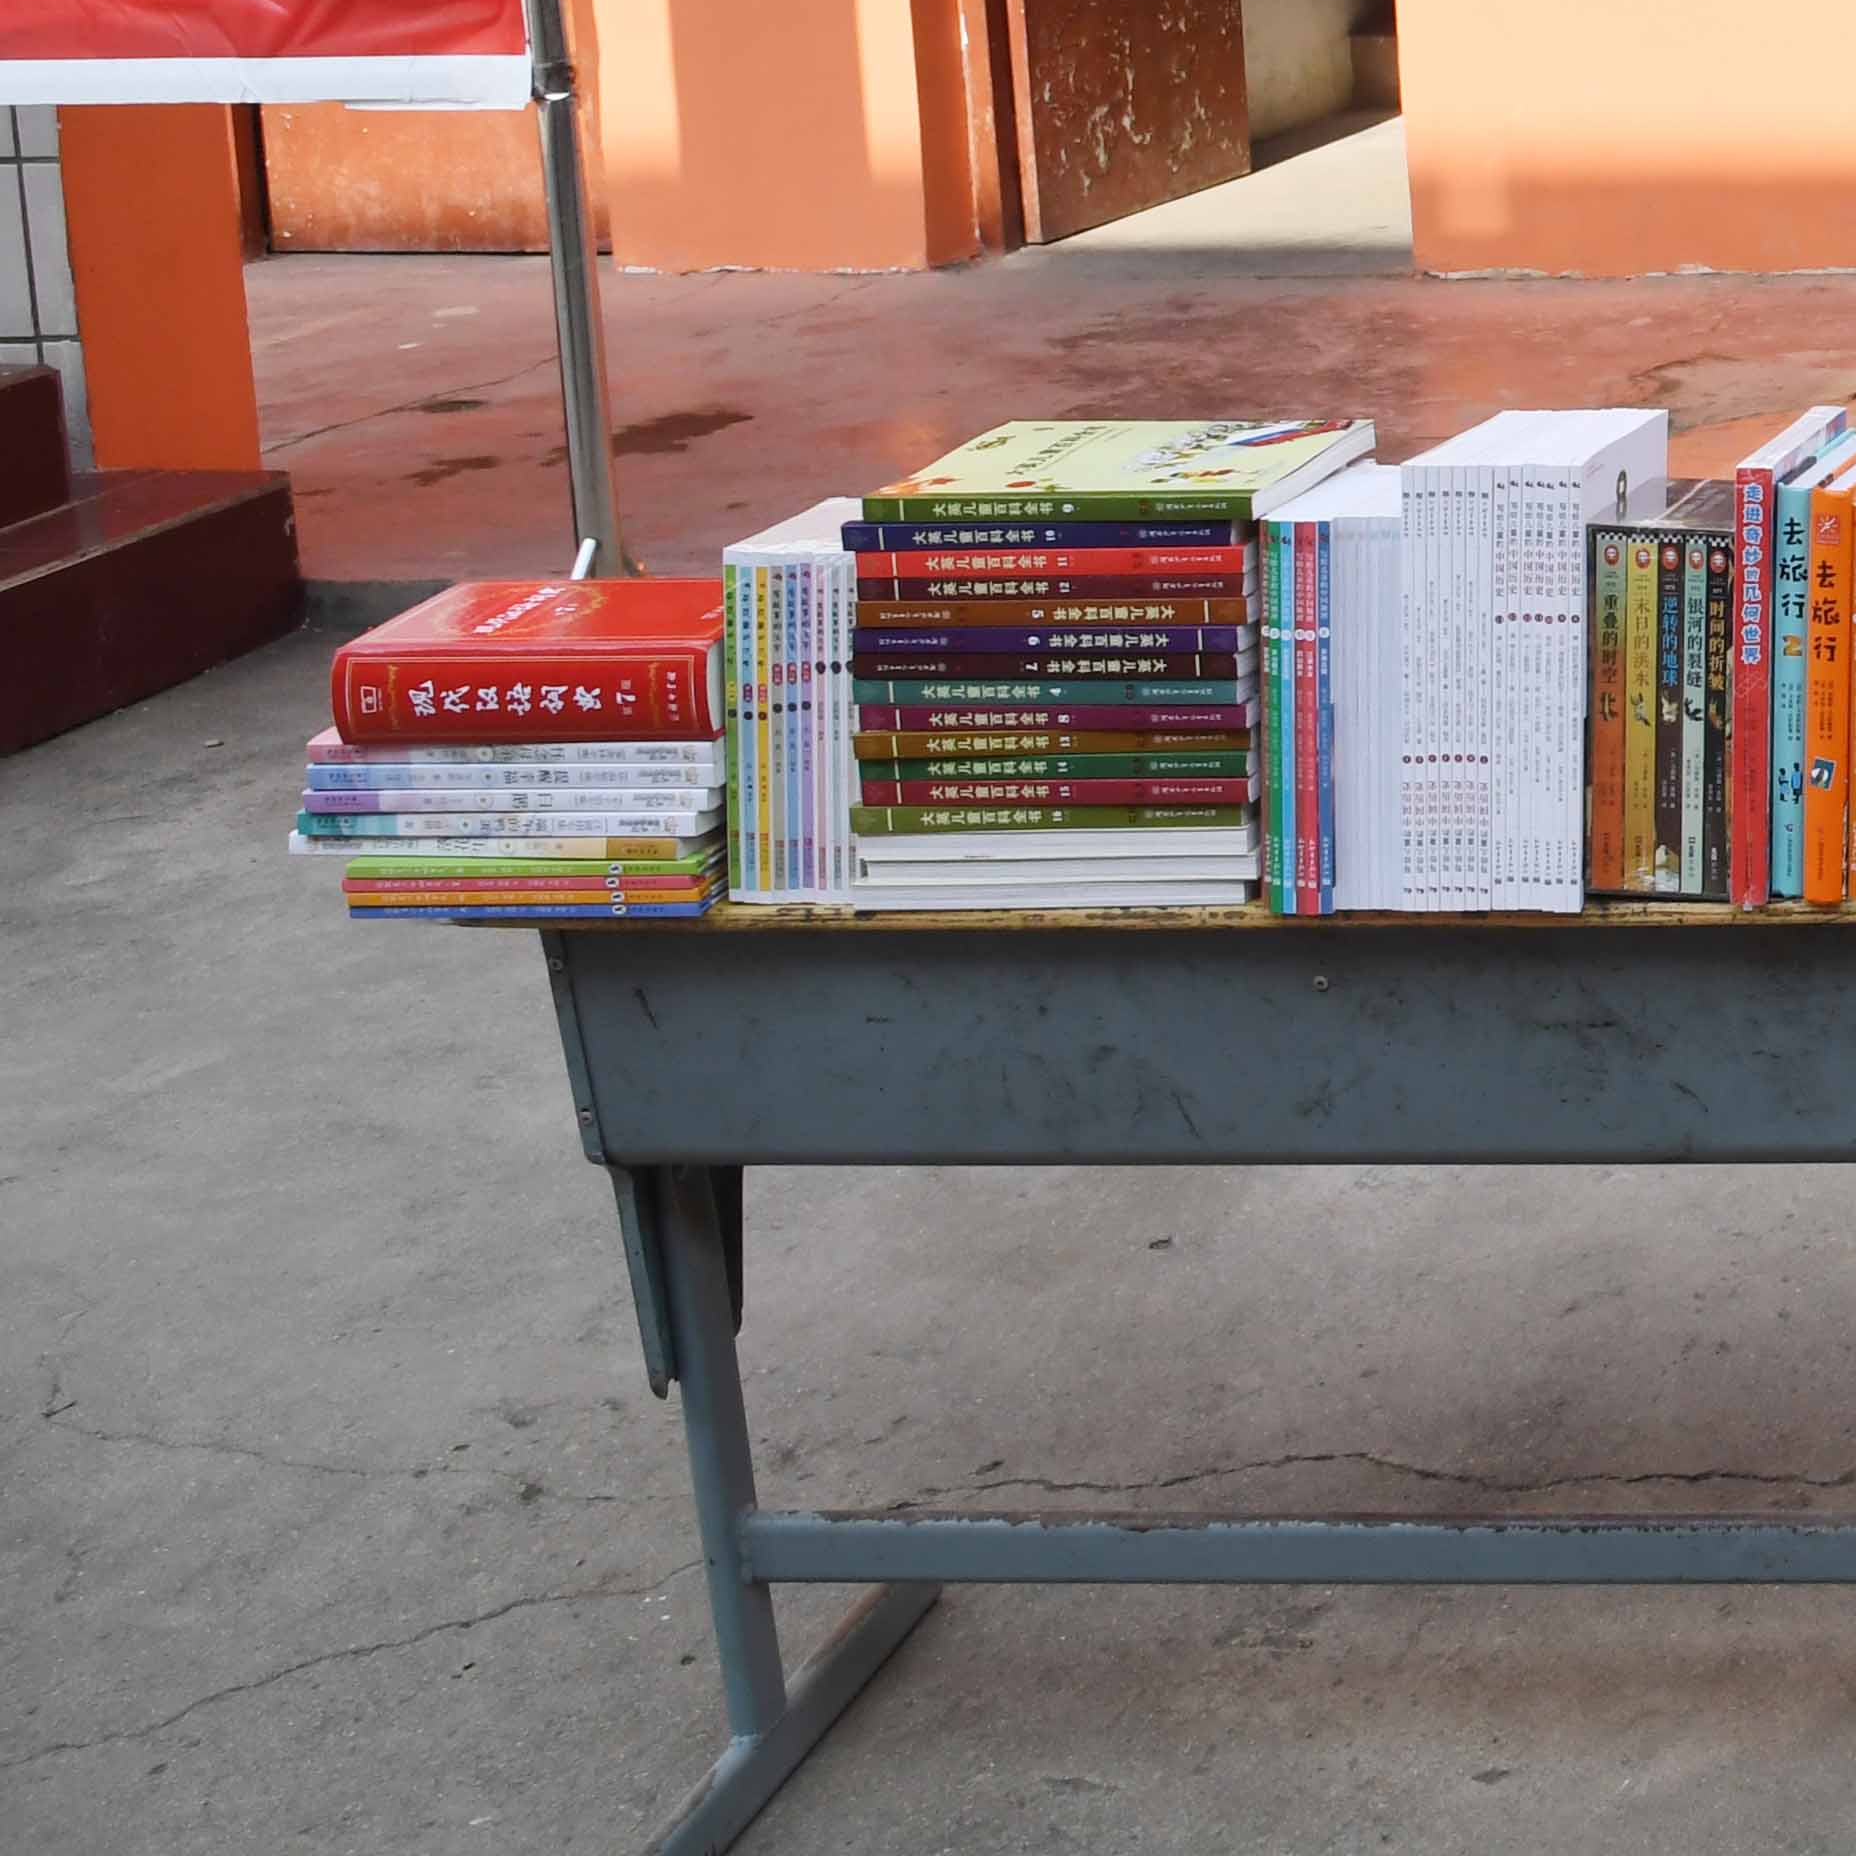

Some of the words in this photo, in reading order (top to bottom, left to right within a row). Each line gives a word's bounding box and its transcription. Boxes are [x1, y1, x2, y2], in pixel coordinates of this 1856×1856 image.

[932, 502, 1054, 517] 大英儿童百科全书
[911, 528, 1036, 545] 大英儿童百科全书
[925, 555, 1048, 571] 大英儿童百科全书
[1779, 517, 1809, 619] 去旅行
[1741, 483, 1764, 665] 走进奇妙的几何世界
[927, 581, 1050, 598] 大英儿童百科全书
[1052, 604, 1176, 622] 大英儿童百科全书
[1812, 560, 1840, 662] 去旅行
[1048, 632, 1170, 649] 大英儿童百科全书
[1662, 597, 1680, 687] 逆转的地球
[1687, 598, 1704, 688] 银河的裂缝
[1782, 634, 1803, 657] 2
[1046, 658, 1168, 675] 大英儿童百科全书
[408, 679, 602, 717] 现代汉语词典
[919, 683, 1042, 700] 大英儿童百科全书
[928, 711, 1050, 727] 大英儿童百科全书
[926, 734, 1050, 753] 大英儿童百科全书
[926, 759, 1049, 777] 大英儿童百科全书
[929, 784, 1050, 801] 大英儿童百科全书
[919, 810, 1043, 826] 大英儿童百科全书
